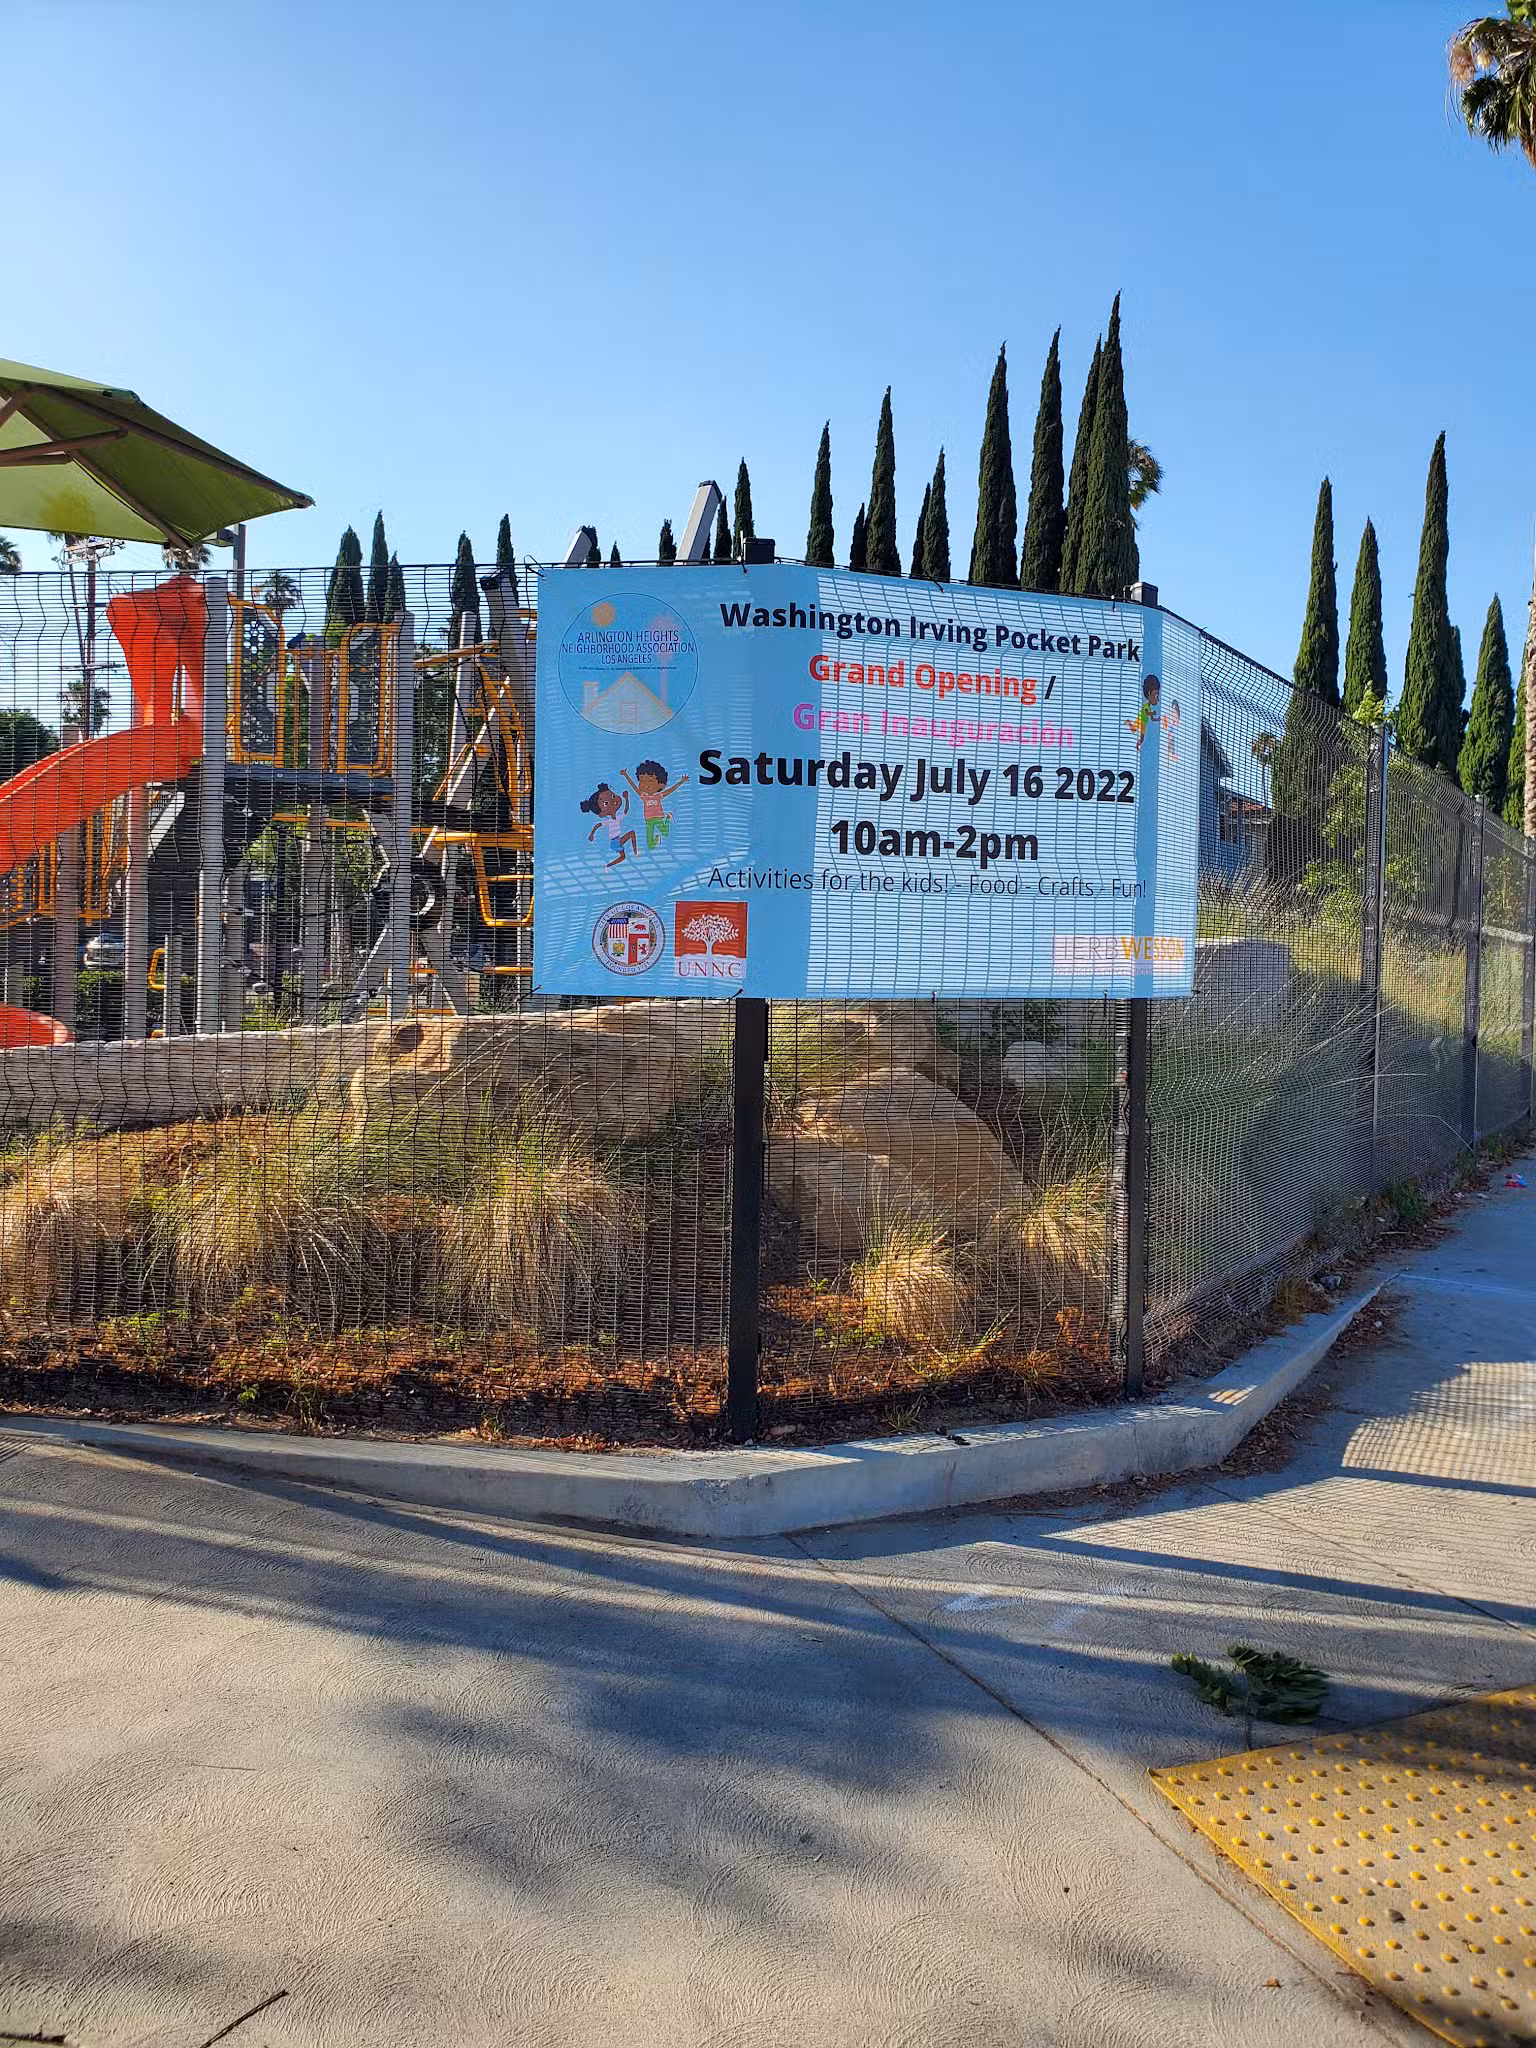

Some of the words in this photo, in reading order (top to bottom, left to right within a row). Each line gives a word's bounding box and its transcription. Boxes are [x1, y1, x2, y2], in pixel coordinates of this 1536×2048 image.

[577, 630, 633, 643] ARLINGTON
[636, 630, 679, 642] HEIGHTS
[720, 602, 900, 639] Washington
[910, 616, 987, 652] Irving
[995, 625, 1081, 655] Pocket
[1088, 635, 1140, 662] Park
[562, 643, 634, 655] NEIGHBORHOOD
[636, 642, 694, 653] ASSOCIATION
[601, 655, 616, 665] LOS
[618, 654, 652, 664] ANGELES
[809, 655, 905, 688] Grand
[914, 663, 1038, 705] Opening
[1044, 675, 1057, 700] /
[793, 703, 870, 734] Gran
[699, 749, 904, 801] Saturday
[910, 759, 991, 805] July
[1002, 764, 1044, 798] 16
[1054, 767, 1135, 803] 2022
[831, 820, 1038, 869] 10am-2pm
[707, 867, 814, 890] Activities
[821, 868, 853, 890] for
[860, 871, 895, 892] the
[902, 871, 949, 893] kids!
[969, 875, 1019, 895] Food
[1038, 876, 1094, 896] Crafts
[1112, 879, 1147, 898] Fun!
[1121, 937, 1184, 960] WESSON
[678, 962, 741, 977] UNNC
